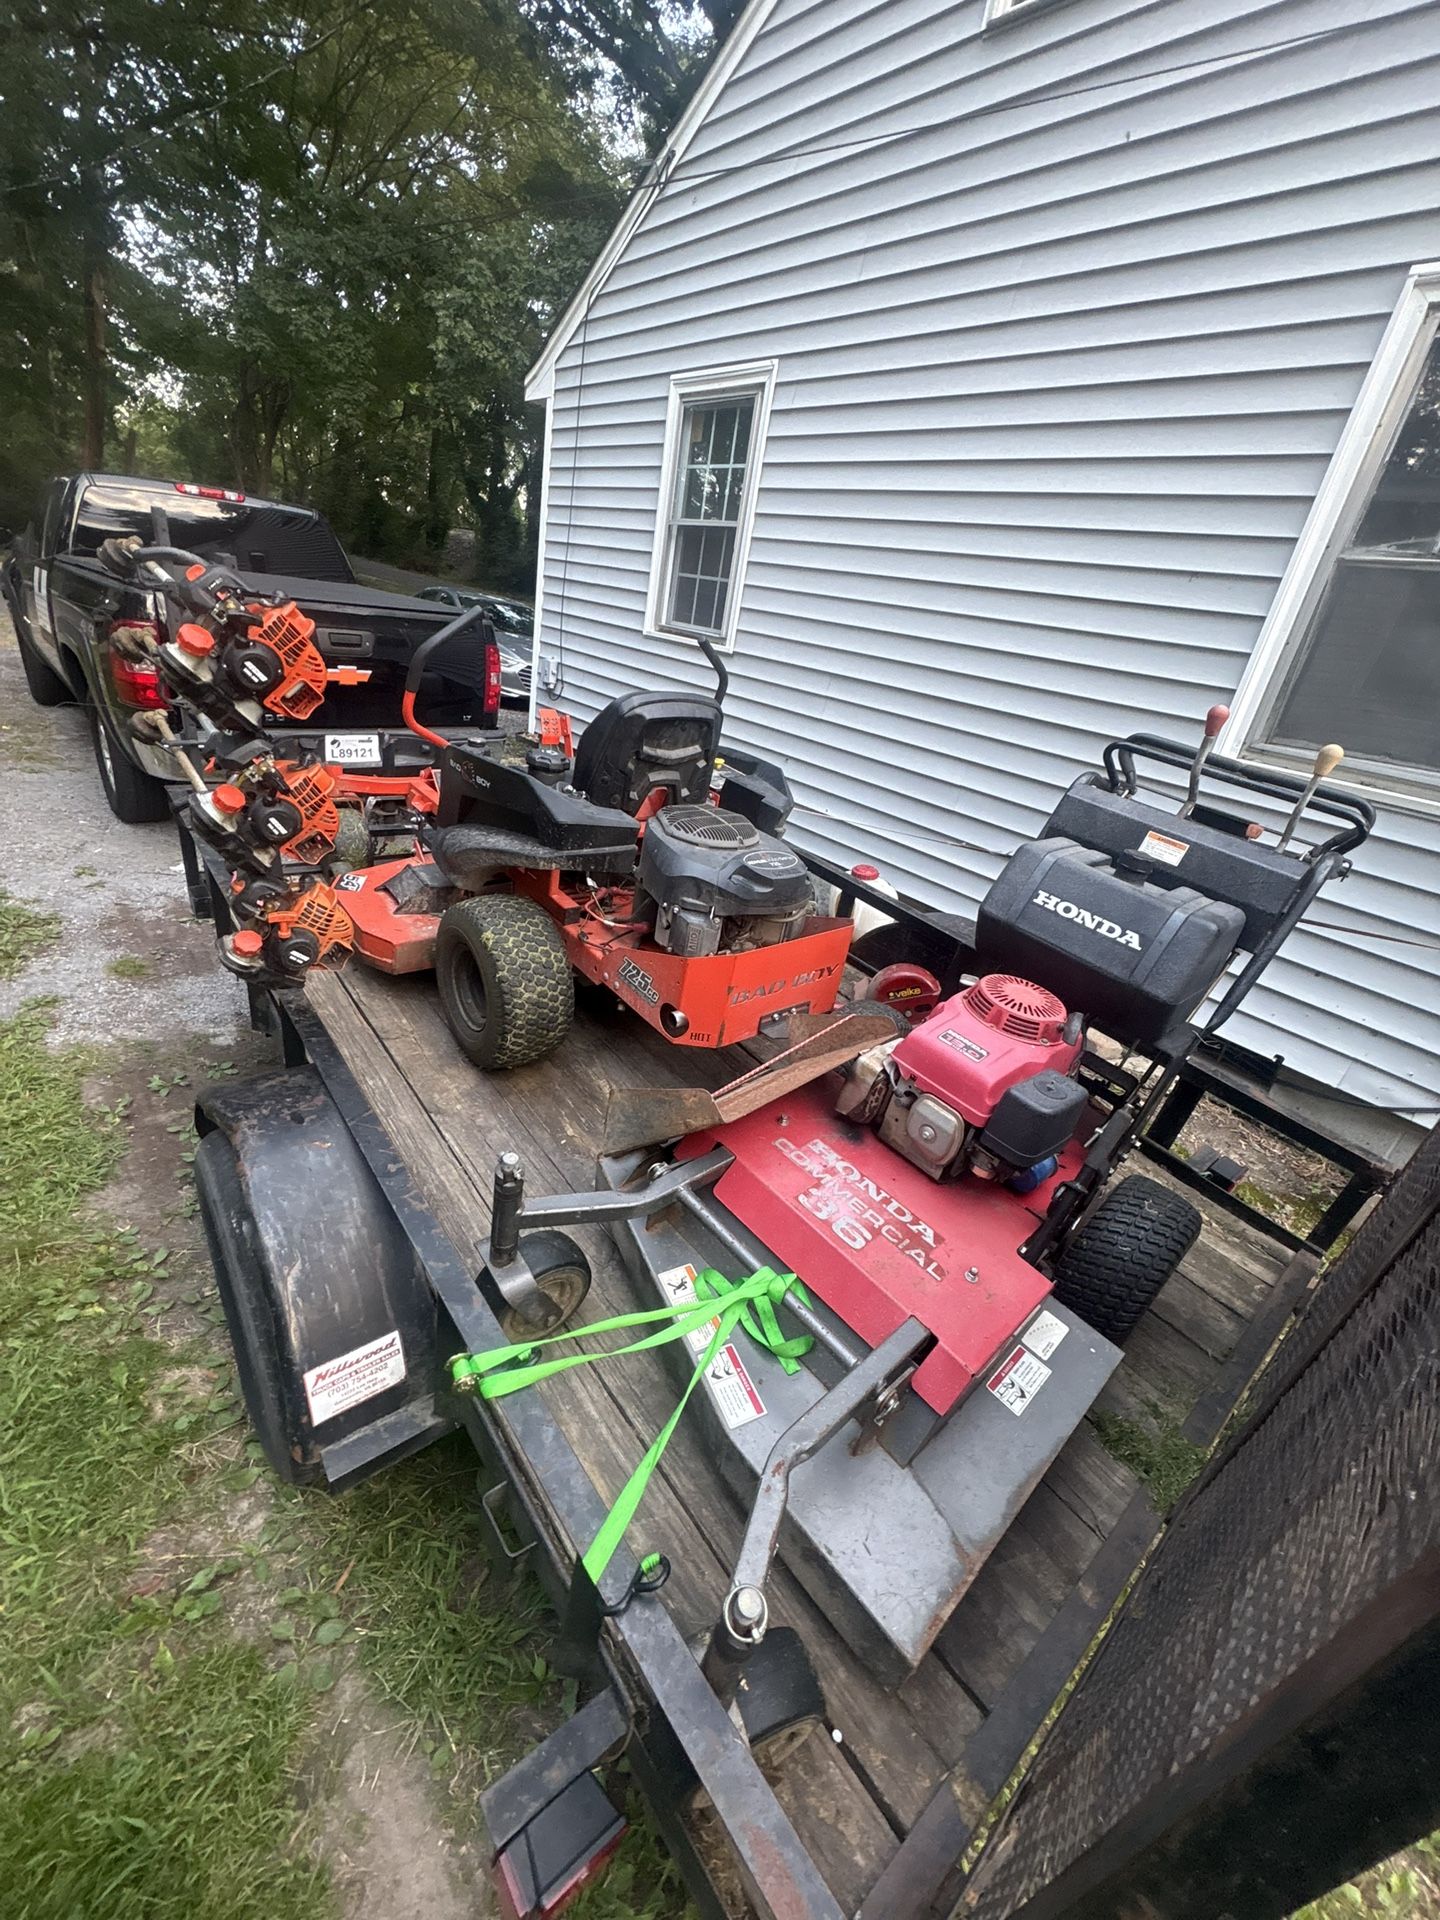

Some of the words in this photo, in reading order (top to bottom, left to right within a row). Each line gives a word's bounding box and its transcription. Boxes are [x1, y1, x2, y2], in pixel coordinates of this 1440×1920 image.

[331, 748, 373, 758] L89121
[1033, 890, 1142, 951] HONDA
[619, 956, 659, 1002] 725cc
[730, 980, 786, 1005] BAD
[690, 1033, 711, 1042] HOT
[773, 1138, 942, 1282] COMMERCIAL
[807, 1138, 937, 1248] HONDA
[798, 1188, 873, 1250] 36
[327, 1382, 349, 1398] (703)
[352, 1362, 388, 1385] 754-4202
